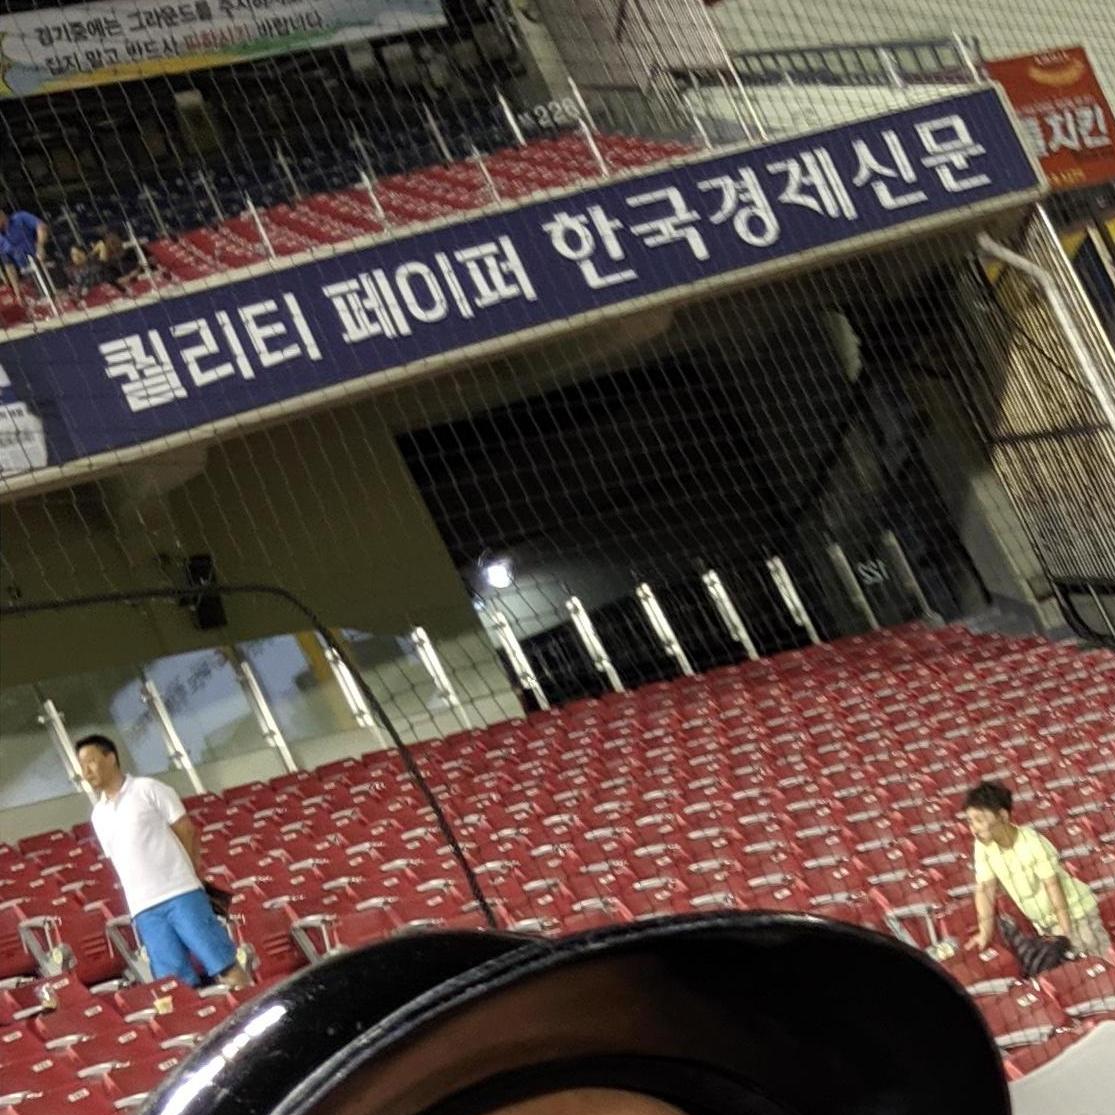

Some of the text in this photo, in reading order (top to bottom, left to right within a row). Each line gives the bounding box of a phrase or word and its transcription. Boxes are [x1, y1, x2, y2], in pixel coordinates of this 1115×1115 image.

[99, 114, 992, 413] 퀄리티 페이퍼 한국경제신문
